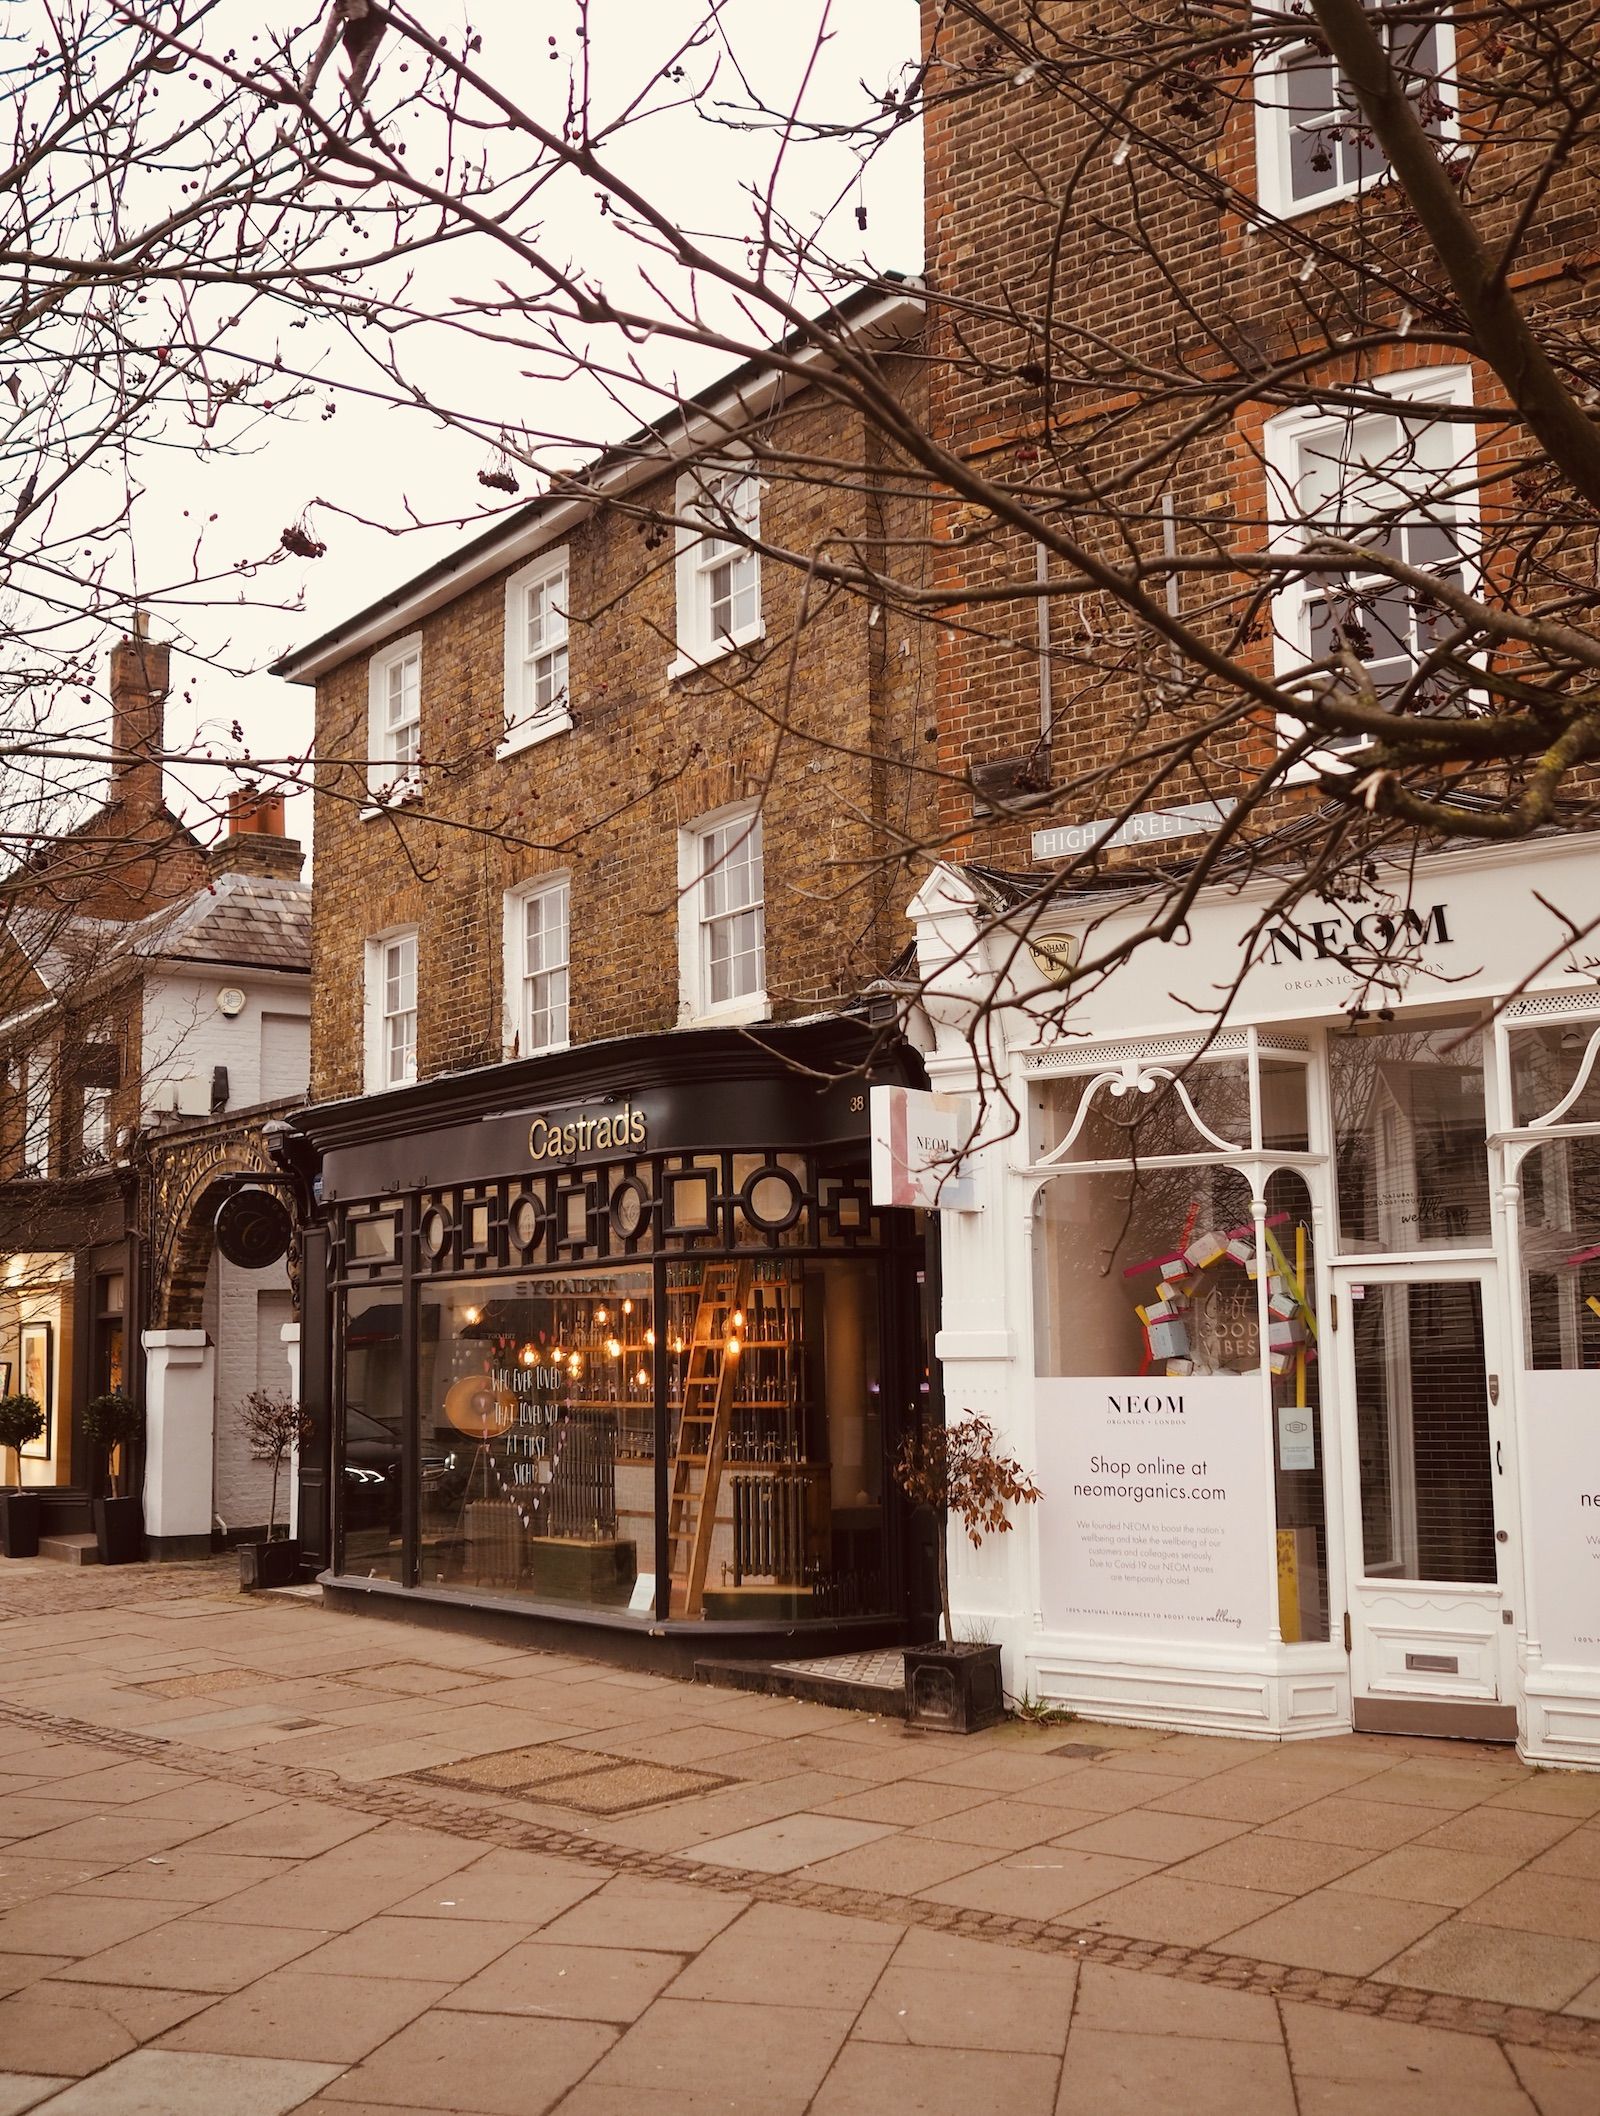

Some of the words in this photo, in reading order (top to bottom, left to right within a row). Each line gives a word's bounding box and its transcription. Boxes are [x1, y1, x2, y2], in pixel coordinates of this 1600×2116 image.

[1043, 826, 1096, 852] HIGH
[1265, 904, 1454, 966] NEOM
[1284, 974, 1359, 991] ORGANICS
[850, 1096, 864, 1112] 38
[529, 1103, 646, 1160] Castrads
[917, 1136, 949, 1152] NEOM
[170, 1142, 227, 1225] WOODCOCK
[491, 1367, 509, 1392] WHO
[513, 1368, 533, 1392] EVER
[536, 1366, 561, 1389] LOVED
[1107, 1395, 1184, 1414] NEOM
[494, 1402, 515, 1426] THAT
[519, 1402, 542, 1427] LOVED
[544, 1403, 559, 1426] NOT
[523, 1435, 545, 1460] FIRST
[1090, 1456, 1131, 1478] Shop
[1136, 1456, 1185, 1476] online
[1191, 1461, 1207, 1476] at
[1074, 1484, 1226, 1503] neomorganics.com
[1076, 1520, 1090, 1528] We
[1091, 1520, 1121, 1530] founded
[1122, 1522, 1151, 1531] NEOM
[1161, 1524, 1182, 1532] boost
[1183, 1524, 1194, 1533] the
[1081, 1534, 1115, 1545] wellbeing
[1149, 1536, 1160, 1544] the
[1162, 1536, 1198, 1548] wellbeing
[1088, 1548, 1122, 1556] customers
[1123, 1548, 1138, 1557] and
[1140, 1549, 1179, 1560] colleagues
[1089, 1559, 1104, 1567] Due
[1162, 1562, 1191, 1572] NEOM
[1193, 1565, 1214, 1573] stores
[1124, 1574, 1163, 1585] temporarily
[1206, 1608, 1242, 1629] wellbeing
